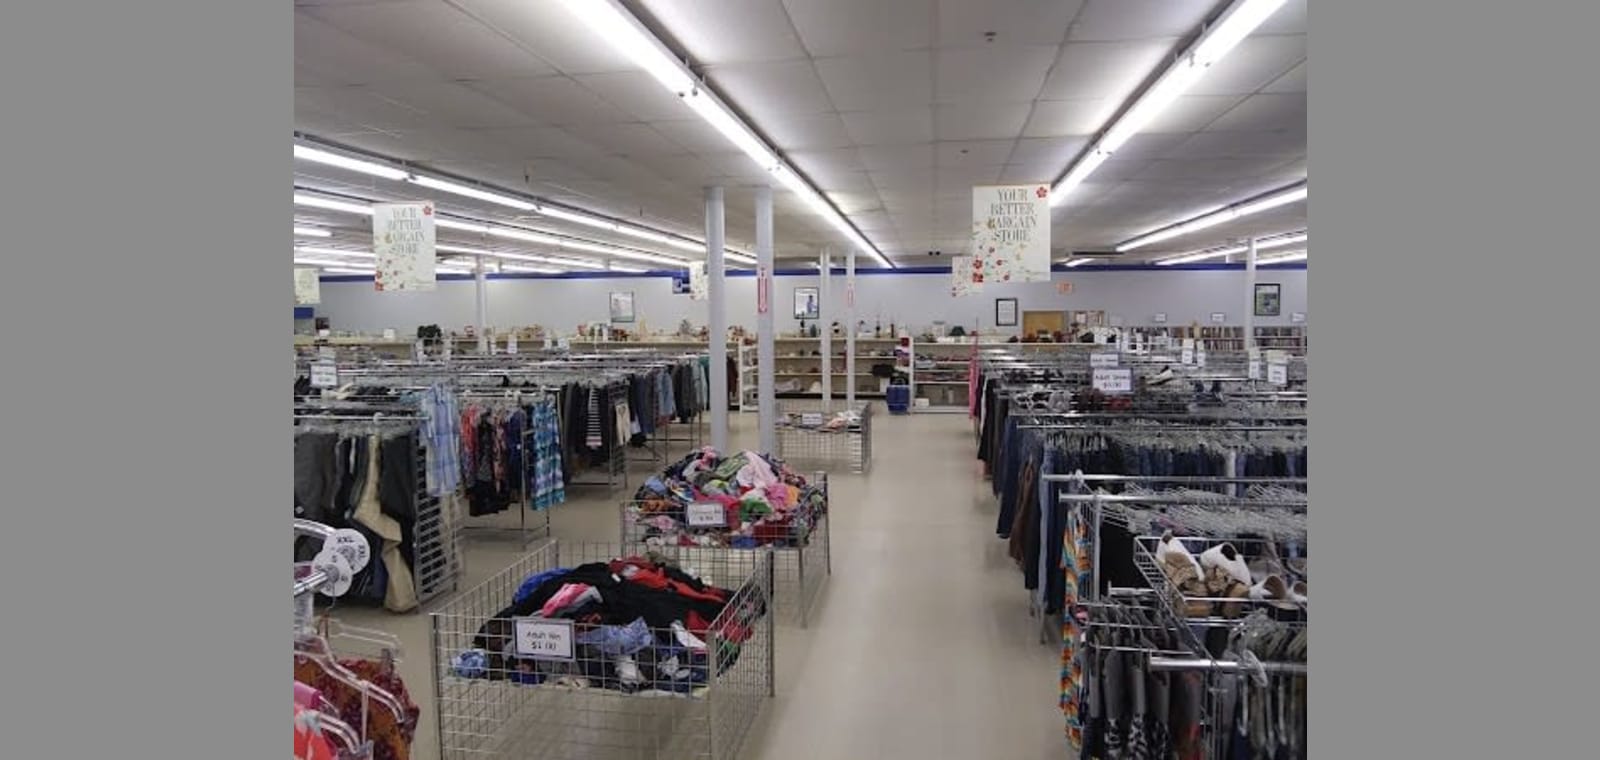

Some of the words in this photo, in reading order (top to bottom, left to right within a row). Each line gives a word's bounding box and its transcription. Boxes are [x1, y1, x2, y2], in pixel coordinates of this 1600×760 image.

[998, 188, 1028, 201] YOUR
[392, 207, 417, 218] YOUR
[990, 202, 1036, 215] BETTER
[387, 219, 422, 231] BETTER
[994, 229, 1029, 242] STORE
[336, 535, 355, 544] XXL
